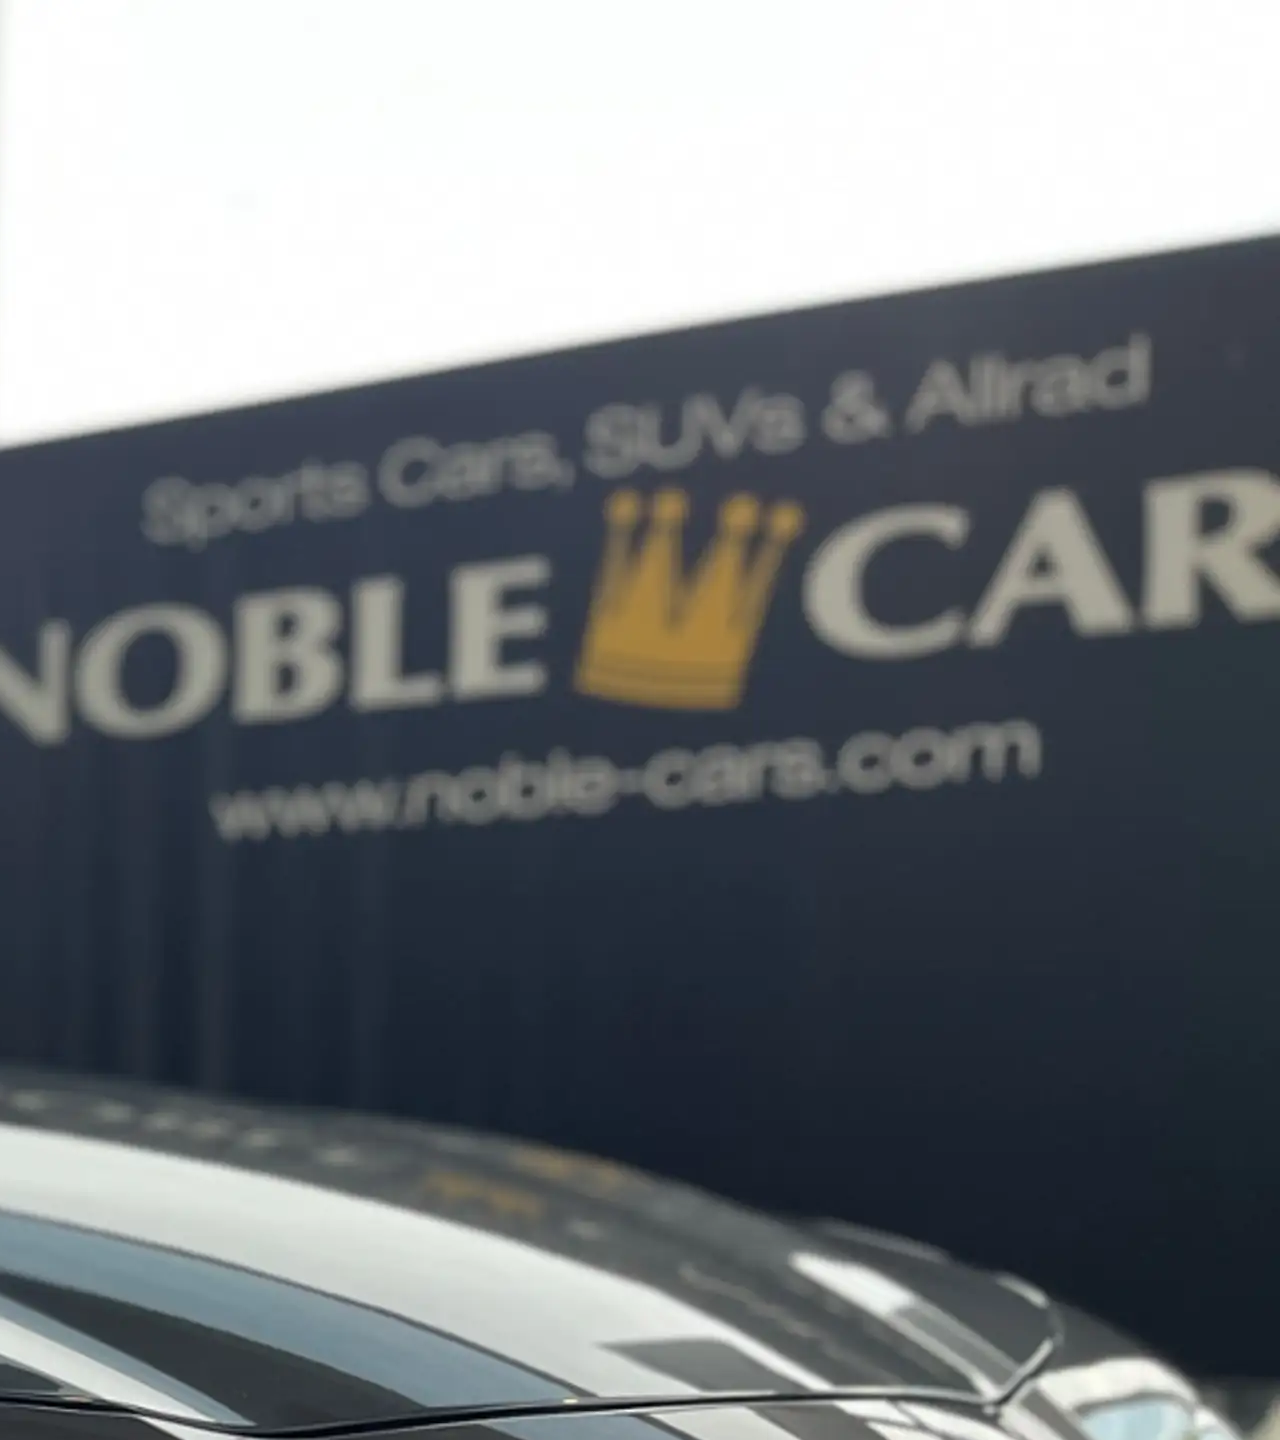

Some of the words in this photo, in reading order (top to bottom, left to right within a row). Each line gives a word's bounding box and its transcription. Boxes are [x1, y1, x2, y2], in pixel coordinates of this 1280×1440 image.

[142, 460, 370, 552] Sports
[379, 432, 576, 506] Cars,
[584, 387, 806, 479] SUVs
[822, 369, 892, 443] &
[906, 332, 1152, 434] Allrad
[801, 468, 1280, 660] CAR
[210, 720, 1041, 841] www.noble-cars.com
